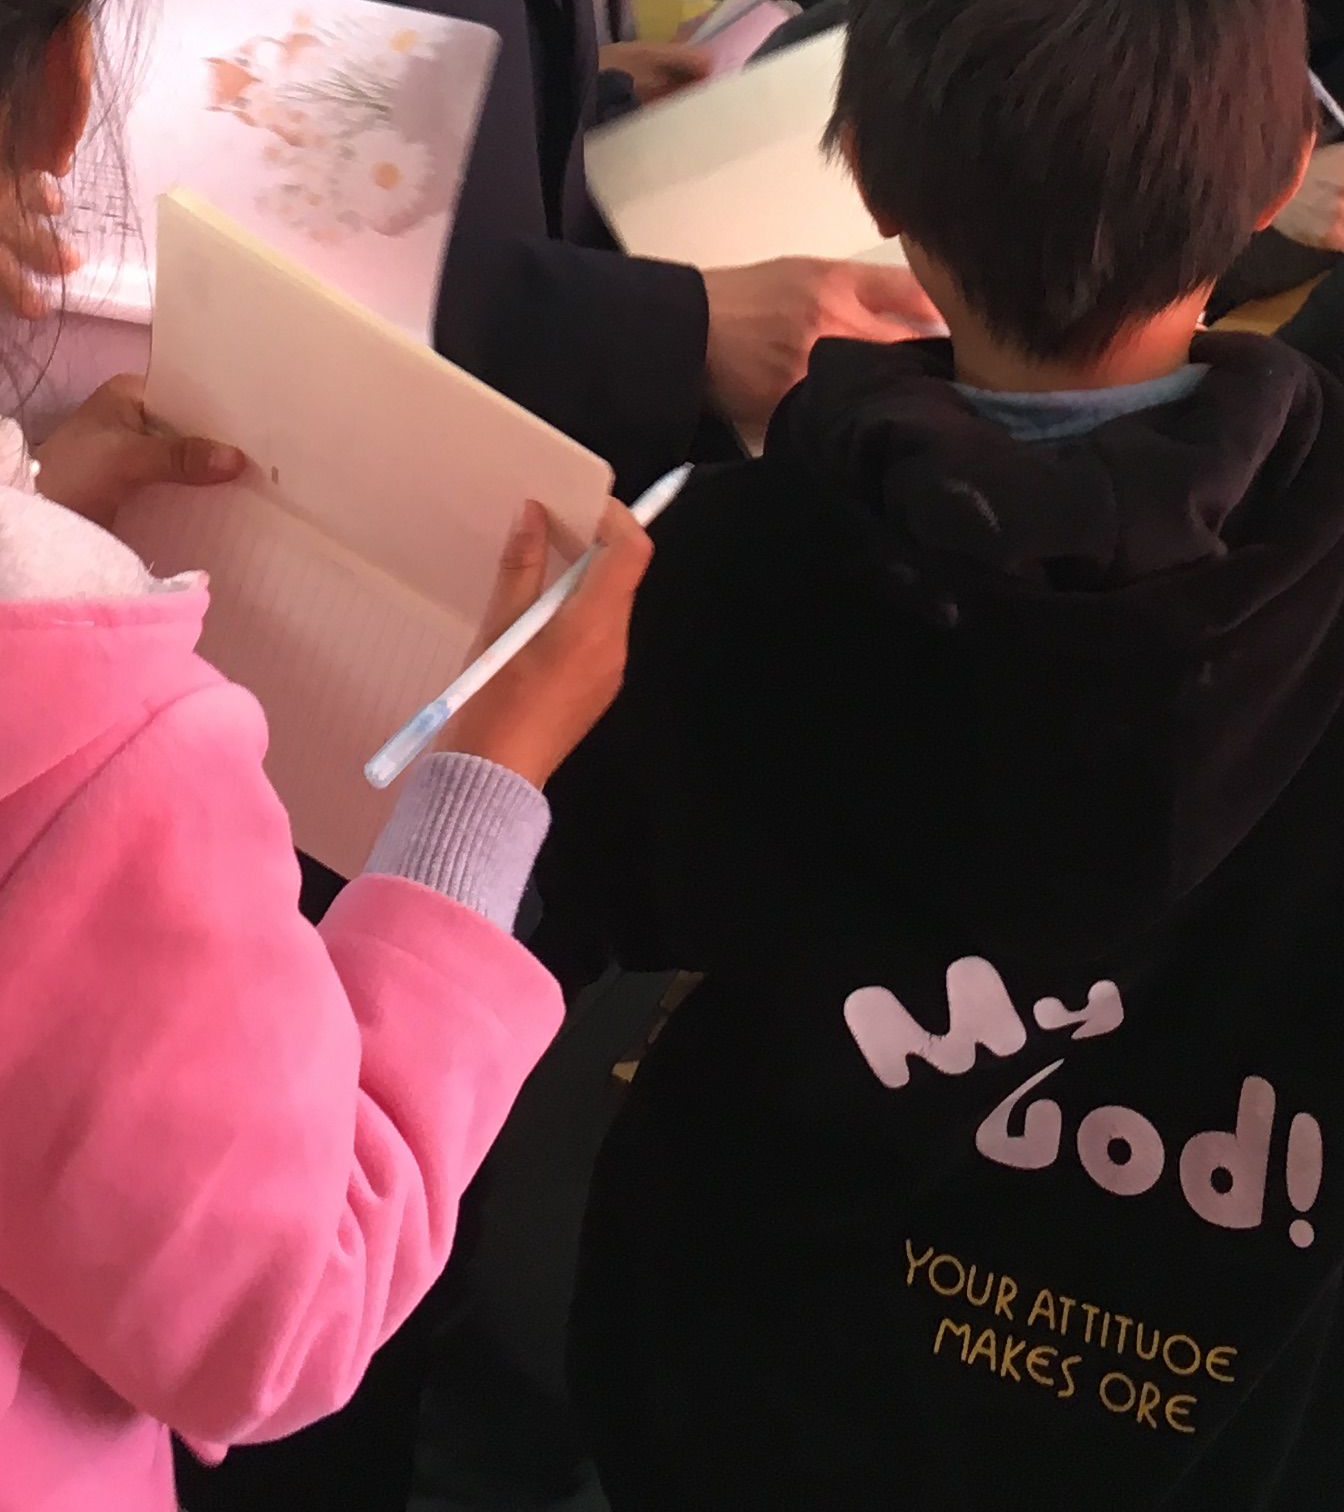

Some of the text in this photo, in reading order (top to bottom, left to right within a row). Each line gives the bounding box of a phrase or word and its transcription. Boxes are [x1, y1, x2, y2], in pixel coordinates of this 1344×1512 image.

[843, 955, 1125, 1089] My
[904, 1239, 1017, 1322] YOUR
[933, 1317, 1082, 1399] MAKES
